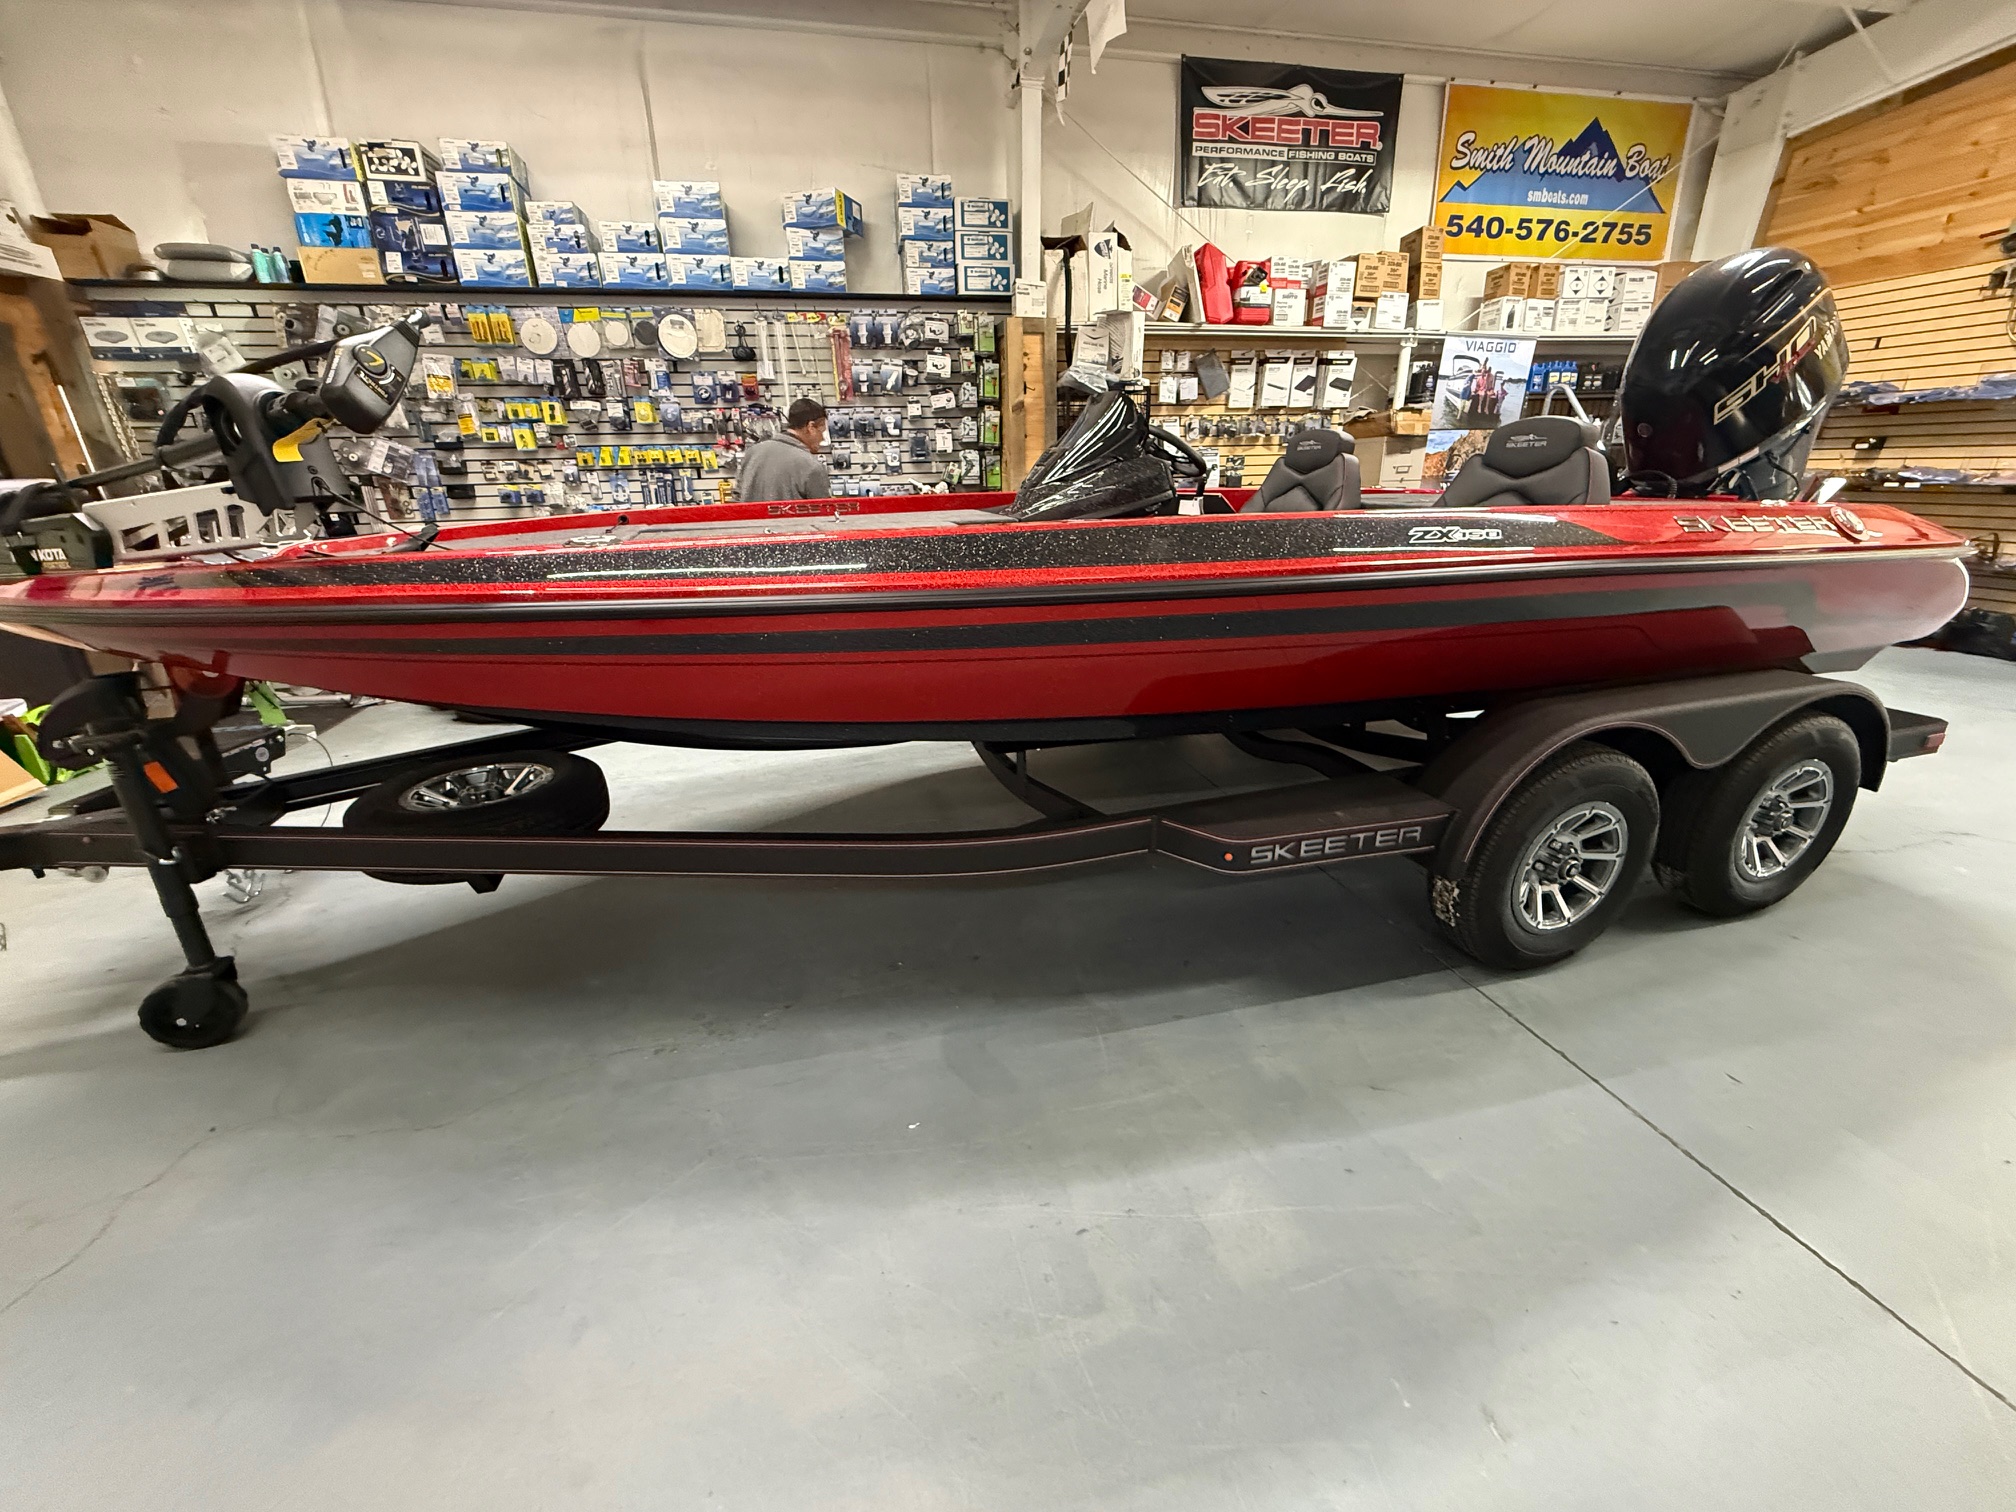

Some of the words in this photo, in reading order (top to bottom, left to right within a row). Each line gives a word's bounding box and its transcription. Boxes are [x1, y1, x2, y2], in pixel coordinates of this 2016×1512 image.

[1193, 112, 1381, 149] SKEETER
[1195, 145, 1285, 158] PERFORMANCE
[1288, 151, 1335, 160] FISHING
[1338, 153, 1375, 163] BOATS
[1450, 130, 1518, 171] Smith
[1520, 134, 1618, 181] Mountain
[1623, 142, 1671, 182] Boat
[1197, 162, 1246, 188] Eat.
[1245, 164, 1310, 203] Sleep.
[1320, 168, 1373, 194] Fish.
[1527, 186, 1588, 206] smboats.com
[1445, 214, 1652, 246] 540-576-2755
[1465, 340, 1517, 353] VIAGGIO
[768, 502, 860, 515] SKEETER
[1673, 515, 1837, 533] SKEETER
[37, 548, 67, 561] KOTA
[1250, 826, 1422, 864] SKEETER
